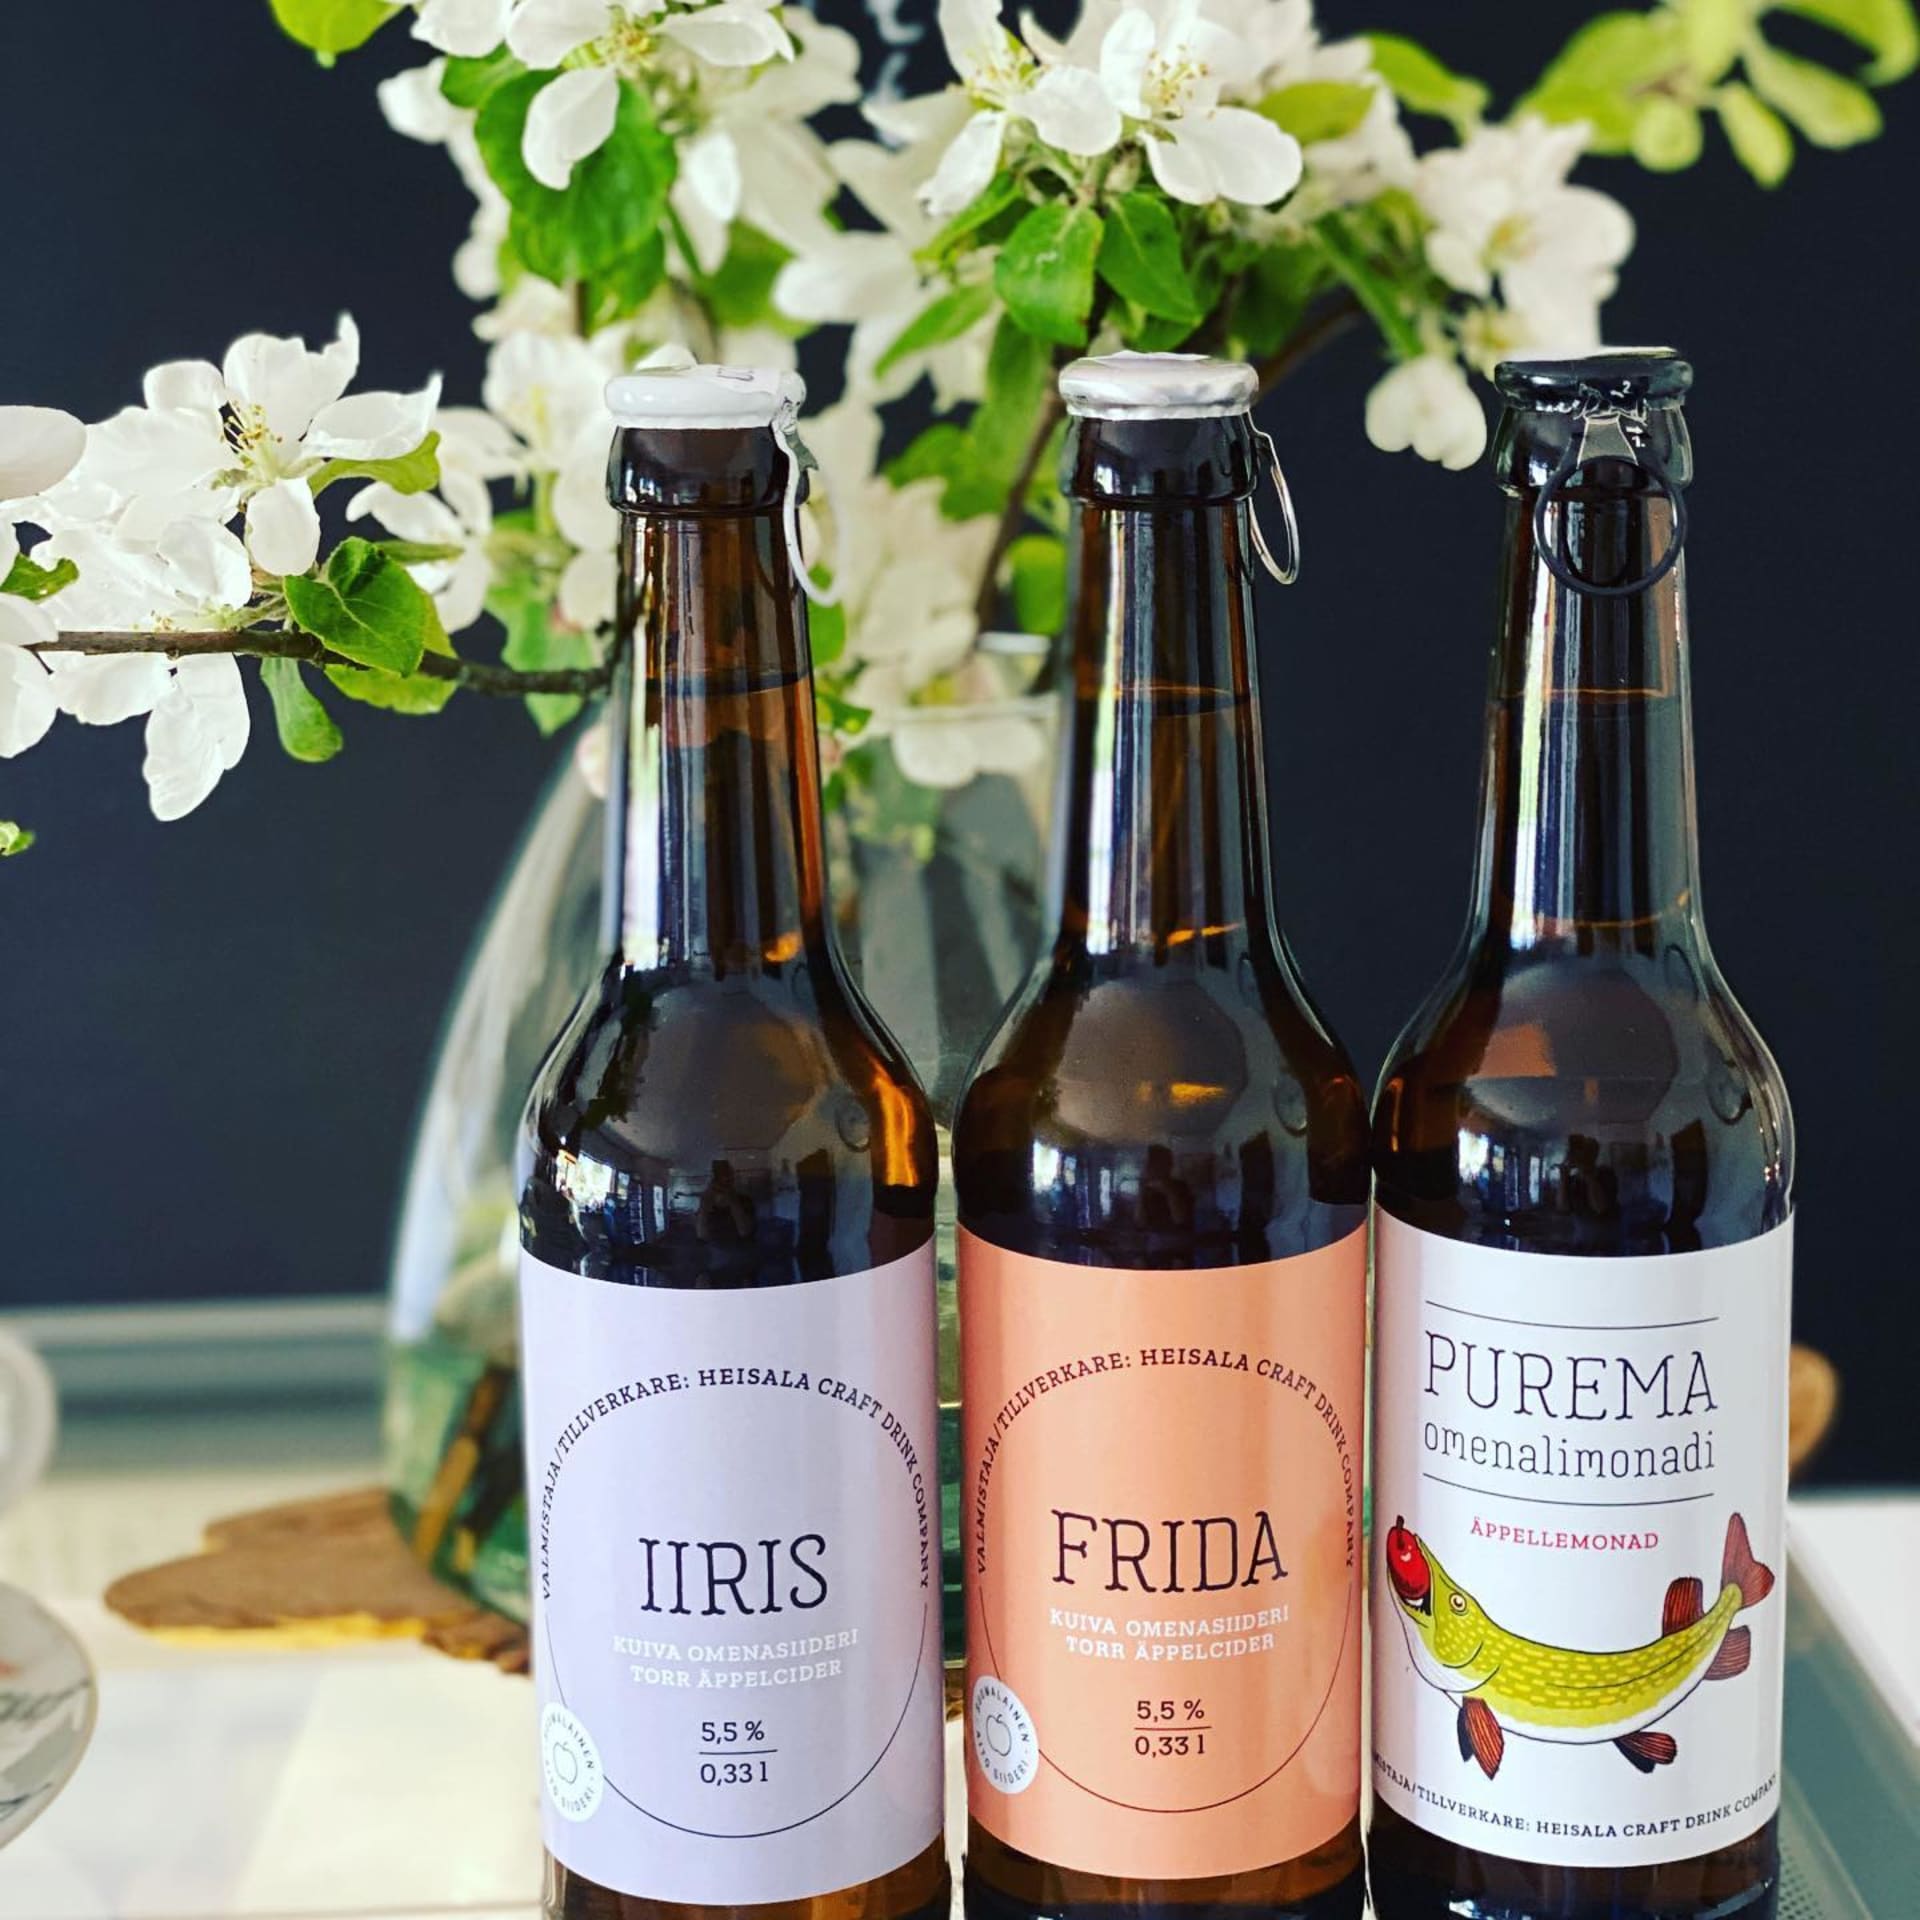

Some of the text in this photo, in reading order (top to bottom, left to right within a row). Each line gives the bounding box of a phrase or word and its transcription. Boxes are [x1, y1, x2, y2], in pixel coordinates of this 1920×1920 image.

[1424, 1330, 1718, 1421] PUREMA
[1140, 1348, 1250, 1371] HEISALA
[1255, 1358, 1318, 1400] CRAFT
[1313, 1392, 1348, 1454] DRINK
[1339, 1453, 1356, 1568] COMPANY
[1424, 1421, 1716, 1479] omenalimonadi
[698, 1367, 810, 1391] HEISALA
[817, 1377, 884, 1419] CRAFT
[880, 1411, 918, 1475] DRINK
[911, 1472, 930, 1589] COMPANY
[1051, 1508, 1290, 1593] FRIDA
[1470, 1515, 1660, 1551] ÄPPELLEMONAD
[638, 1533, 829, 1616] IIRIS
[1050, 1603, 1290, 1639] KUIVA OMENASIIDERI
[612, 1627, 861, 1663] KUIVA OMENASIIDERI
[1065, 1632, 1277, 1662] TORR ÄPPELCIDER
[629, 1658, 843, 1690] TORR ÄPPELCIDER
[1136, 1698, 1206, 1723] 5,5 %
[700, 1719, 766, 1746] 5,5 %
[1134, 1735, 1190, 1758] 0,33
[699, 1763, 753, 1788] 0,33
[1536, 1820, 1617, 1838] HEISALA
[1623, 1819, 1680, 1838] CRAFT
[1684, 1804, 1732, 1829] DRINK
